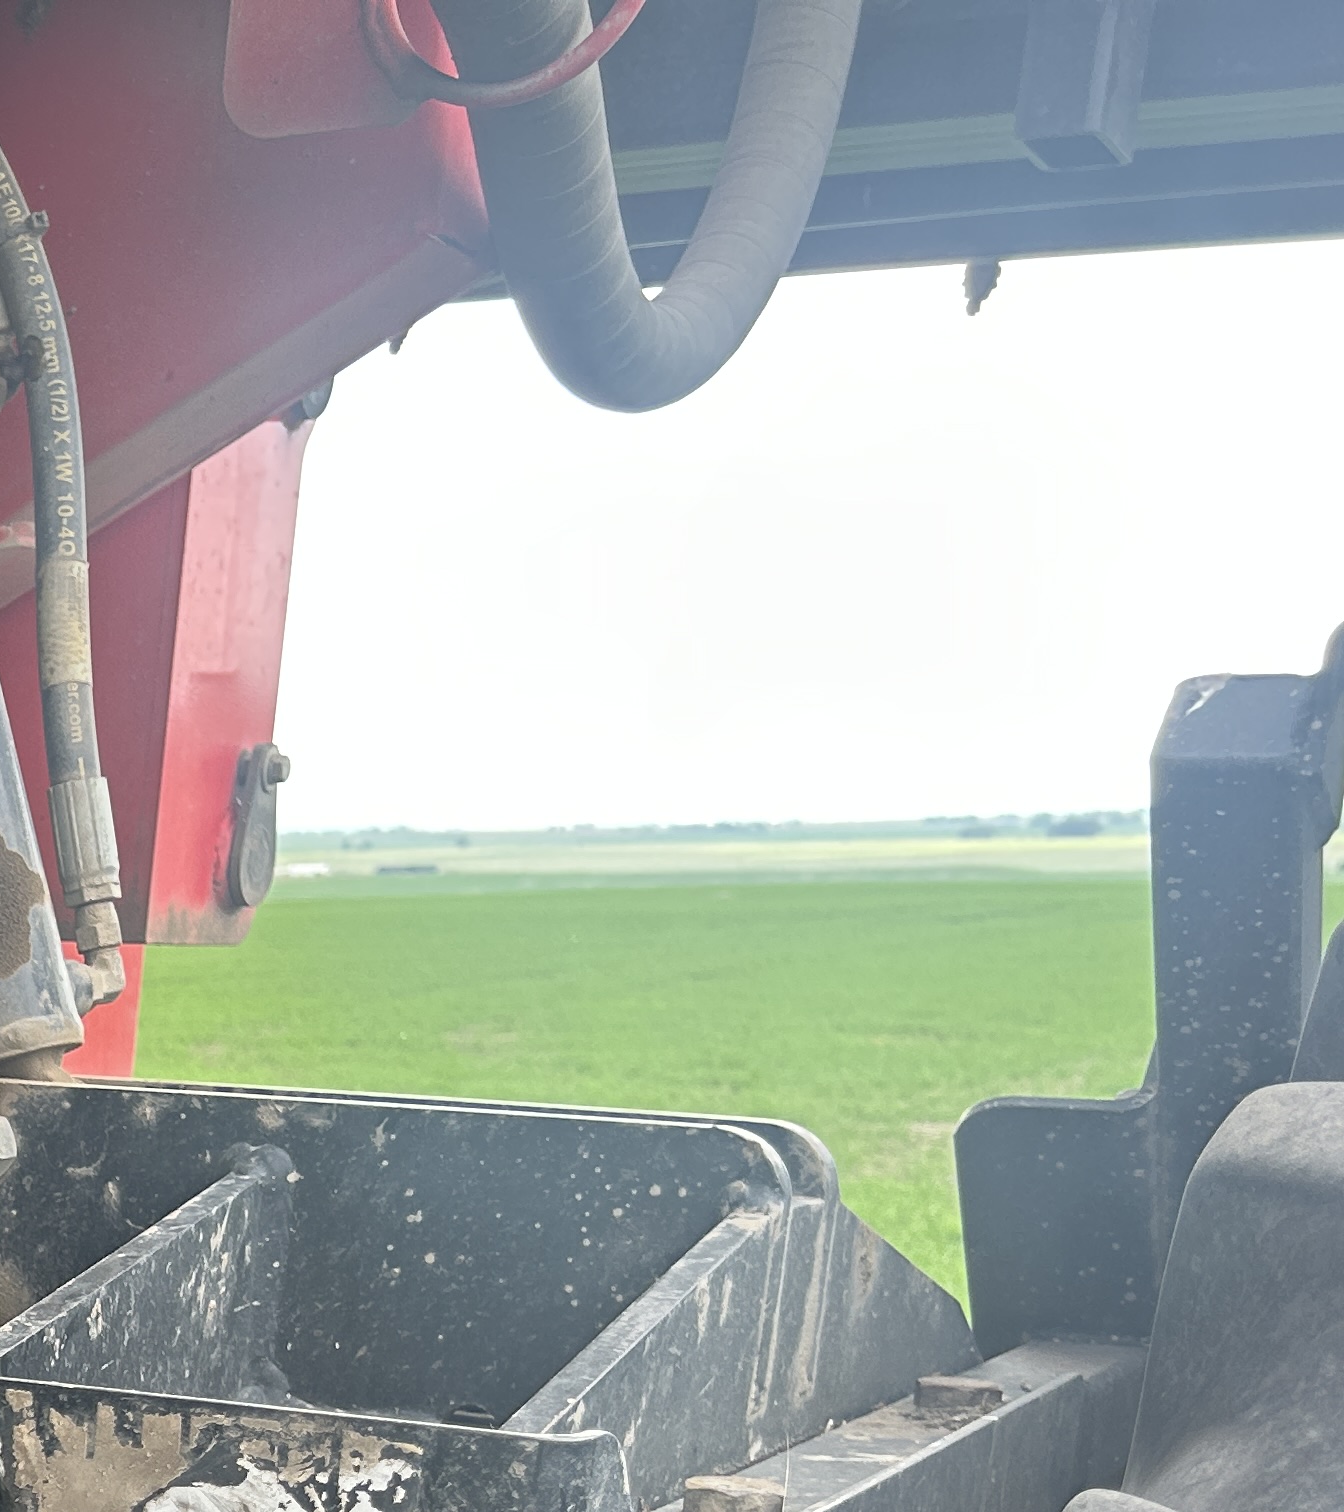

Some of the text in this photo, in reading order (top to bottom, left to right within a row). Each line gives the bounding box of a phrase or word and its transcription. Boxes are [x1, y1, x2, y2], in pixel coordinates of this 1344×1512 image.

[47, 379, 72, 422] (1/2)
[54, 451, 74, 484] 1W
[66, 682, 85, 743] er.com
